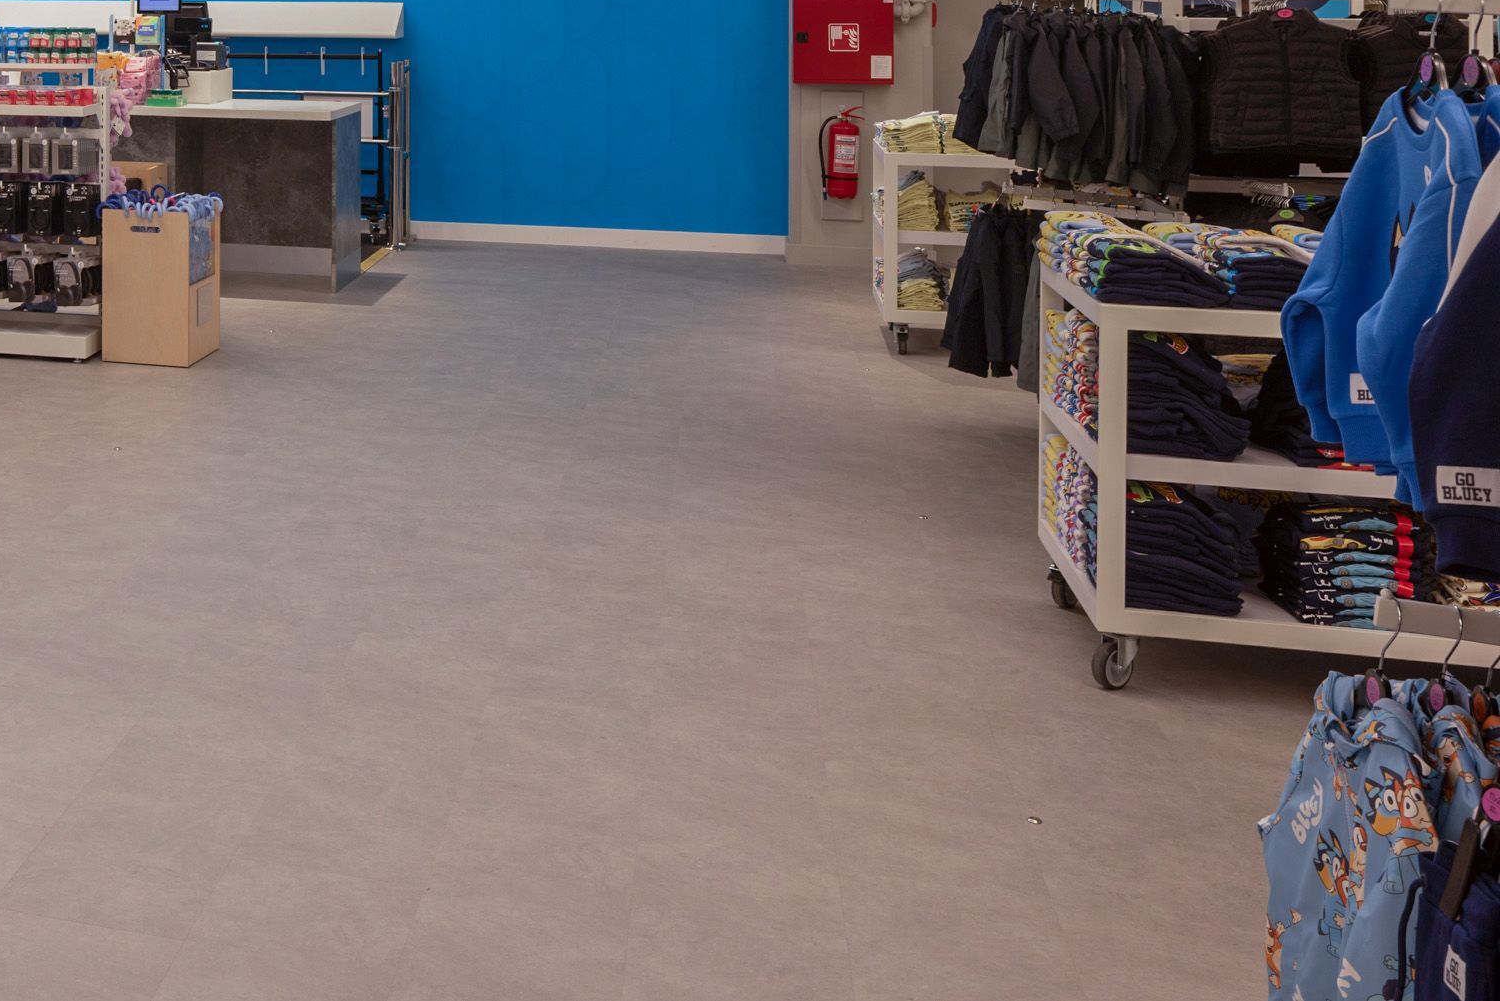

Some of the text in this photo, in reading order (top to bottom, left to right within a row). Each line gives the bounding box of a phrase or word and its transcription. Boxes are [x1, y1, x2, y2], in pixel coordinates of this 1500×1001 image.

[1357, 389, 1373, 401] BL
[1455, 472, 1475, 486] GO
[1442, 486, 1492, 502] BLUEY
